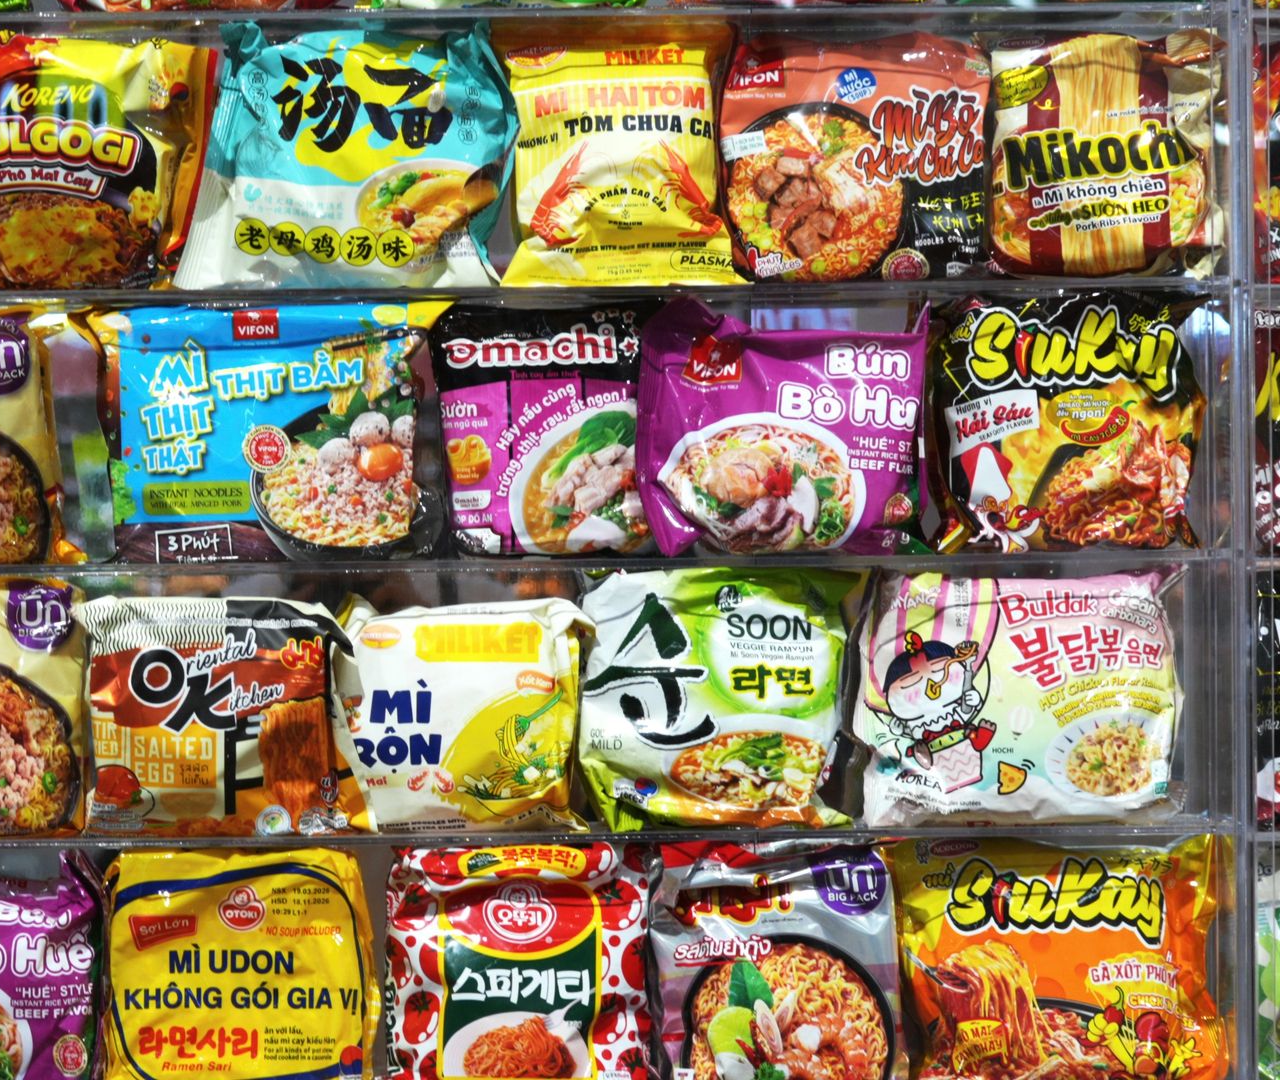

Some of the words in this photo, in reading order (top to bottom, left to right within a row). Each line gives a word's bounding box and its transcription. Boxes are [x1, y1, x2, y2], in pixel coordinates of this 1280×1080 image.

[588, 88, 643, 111] HAI
[648, 85, 704, 108] TÔM
[623, 114, 682, 135] CHUA
[1044, 186, 1064, 203] Mì
[1068, 184, 1116, 200] không
[1120, 179, 1163, 194] chiên
[1076, 221, 1095, 231] Pork
[1121, 214, 1161, 226] Flavour
[238, 323, 275, 335] VIFON
[215, 364, 283, 399] THỊT
[297, 352, 363, 388] BẰM
[149, 488, 187, 499] INSTANT
[194, 488, 242, 498] NOODLES
[1000, 595, 1095, 623] Buldak
[727, 614, 812, 640] SOON
[134, 737, 213, 759] SALTED
[591, 739, 622, 750] MILD
[138, 763, 174, 783] EGG
[282, 927, 302, 936] SOUP
[304, 926, 341, 935] INCLUDED
[170, 943, 201, 973] MÌ
[209, 950, 294, 974] UDON
[1091, 967, 1111, 982] GÀ
[125, 983, 222, 1010] KHÔNG
[230, 984, 278, 1010] GÓI
[287, 987, 331, 1010] GIA
[336, 988, 358, 1016] VỊ
